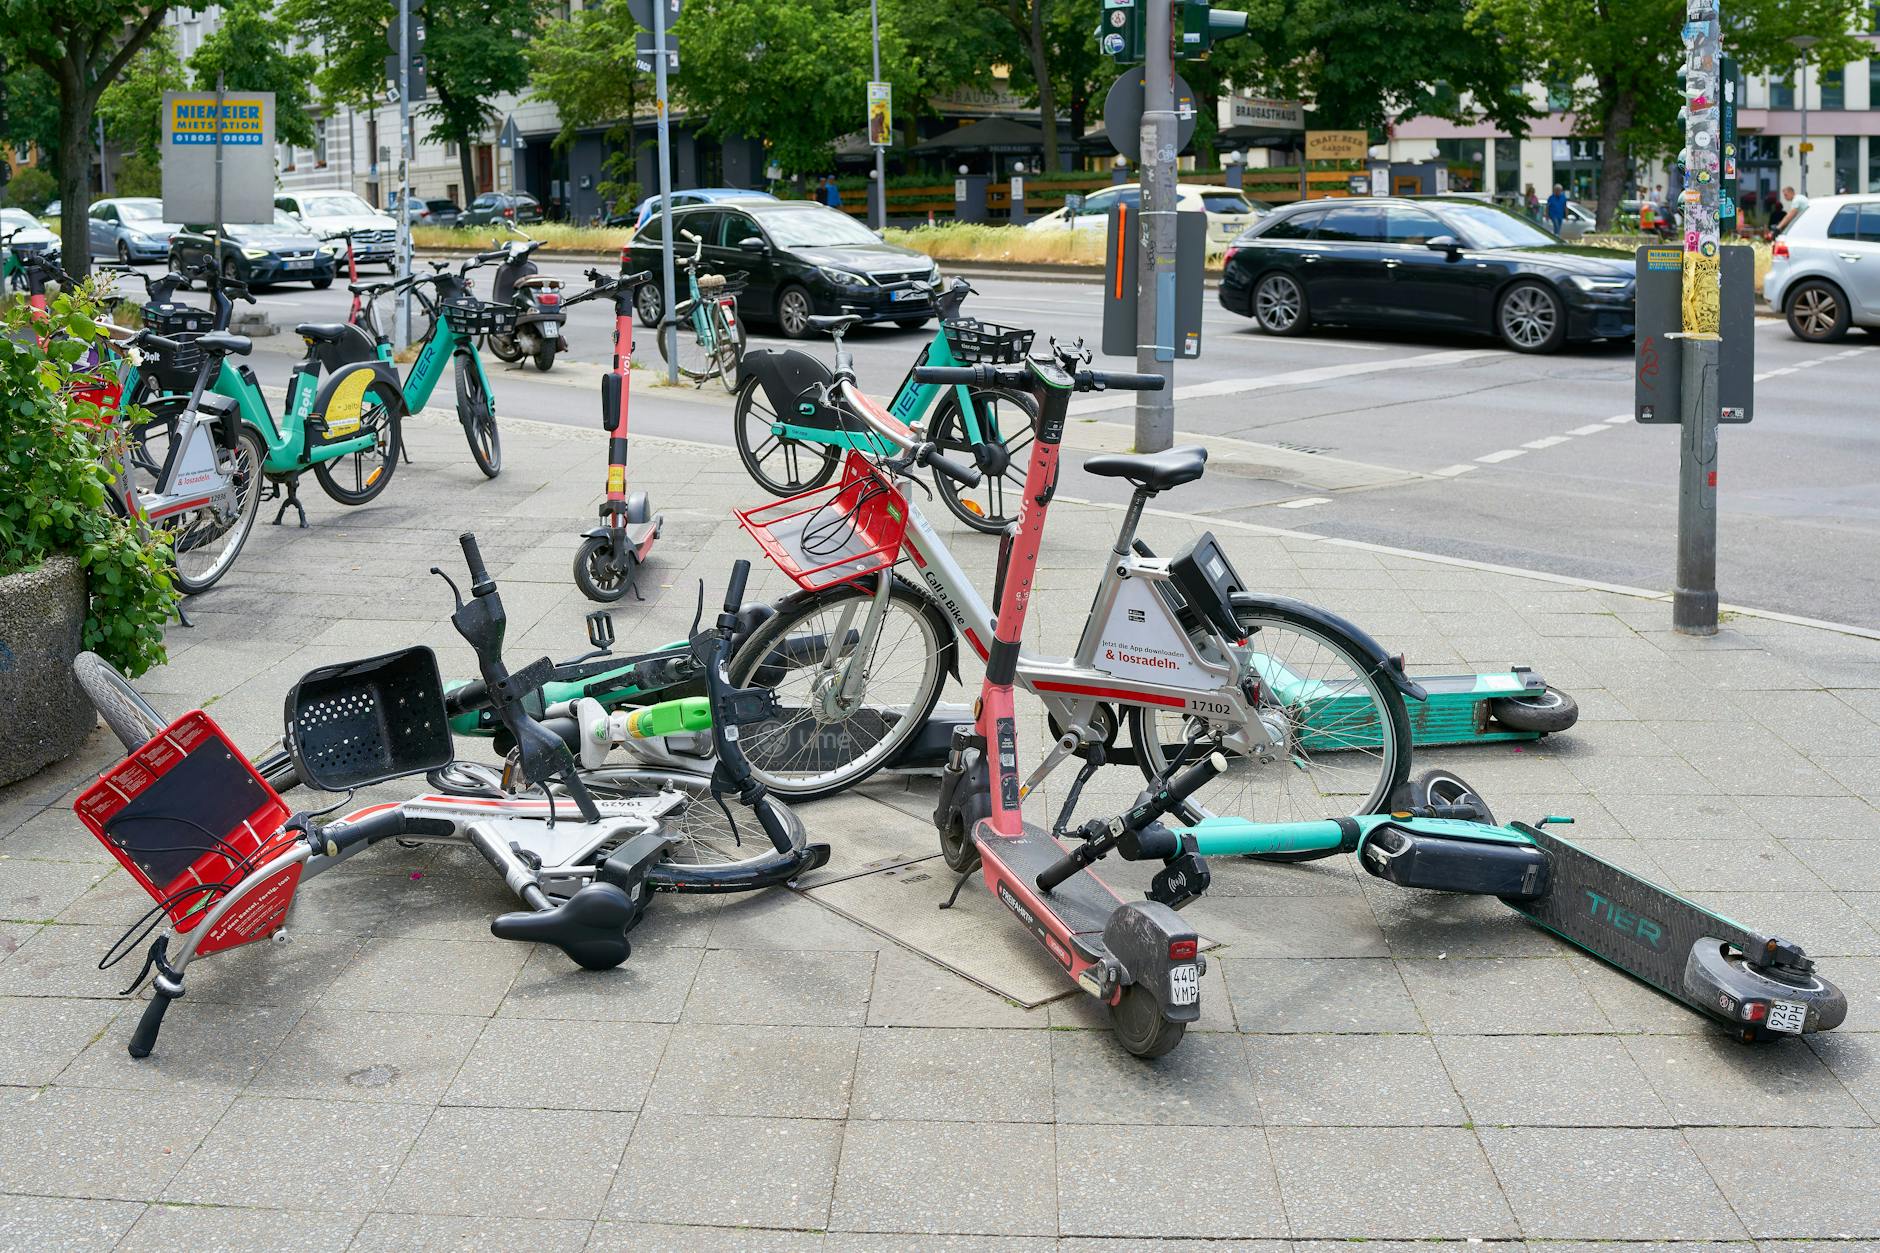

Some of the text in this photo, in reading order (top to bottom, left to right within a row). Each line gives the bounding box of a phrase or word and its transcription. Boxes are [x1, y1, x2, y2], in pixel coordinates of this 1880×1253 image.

[1236, 105, 1297, 121] BRAUGASTHAUS
[176, 121, 259, 129] MIETSATION
[176, 134, 260, 142] 01805-08050
[1310, 134, 1338, 147] CRAFT
[143, 351, 160, 363] Bolt
[621, 353, 631, 376] voi.
[409, 346, 436, 391] TIER
[298, 387, 313, 418] Bolt
[925, 571, 965, 626] Call a Bike
[1105, 649, 1181, 670] & losradeln.
[1118, 642, 1129, 650] die
[1130, 644, 1143, 653] App
[1144, 647, 1185, 658] downloaden
[1191, 700, 1231, 715] 17102
[1585, 890, 1661, 949] TIER
[216, 930, 227, 941] Auf
[227, 918, 239, 931] den
[1174, 967, 1195, 984] 440
[1174, 986, 1196, 1002] YMP
[1771, 1004, 1788, 1027] 928
[1786, 1005, 1804, 1030] WPH
